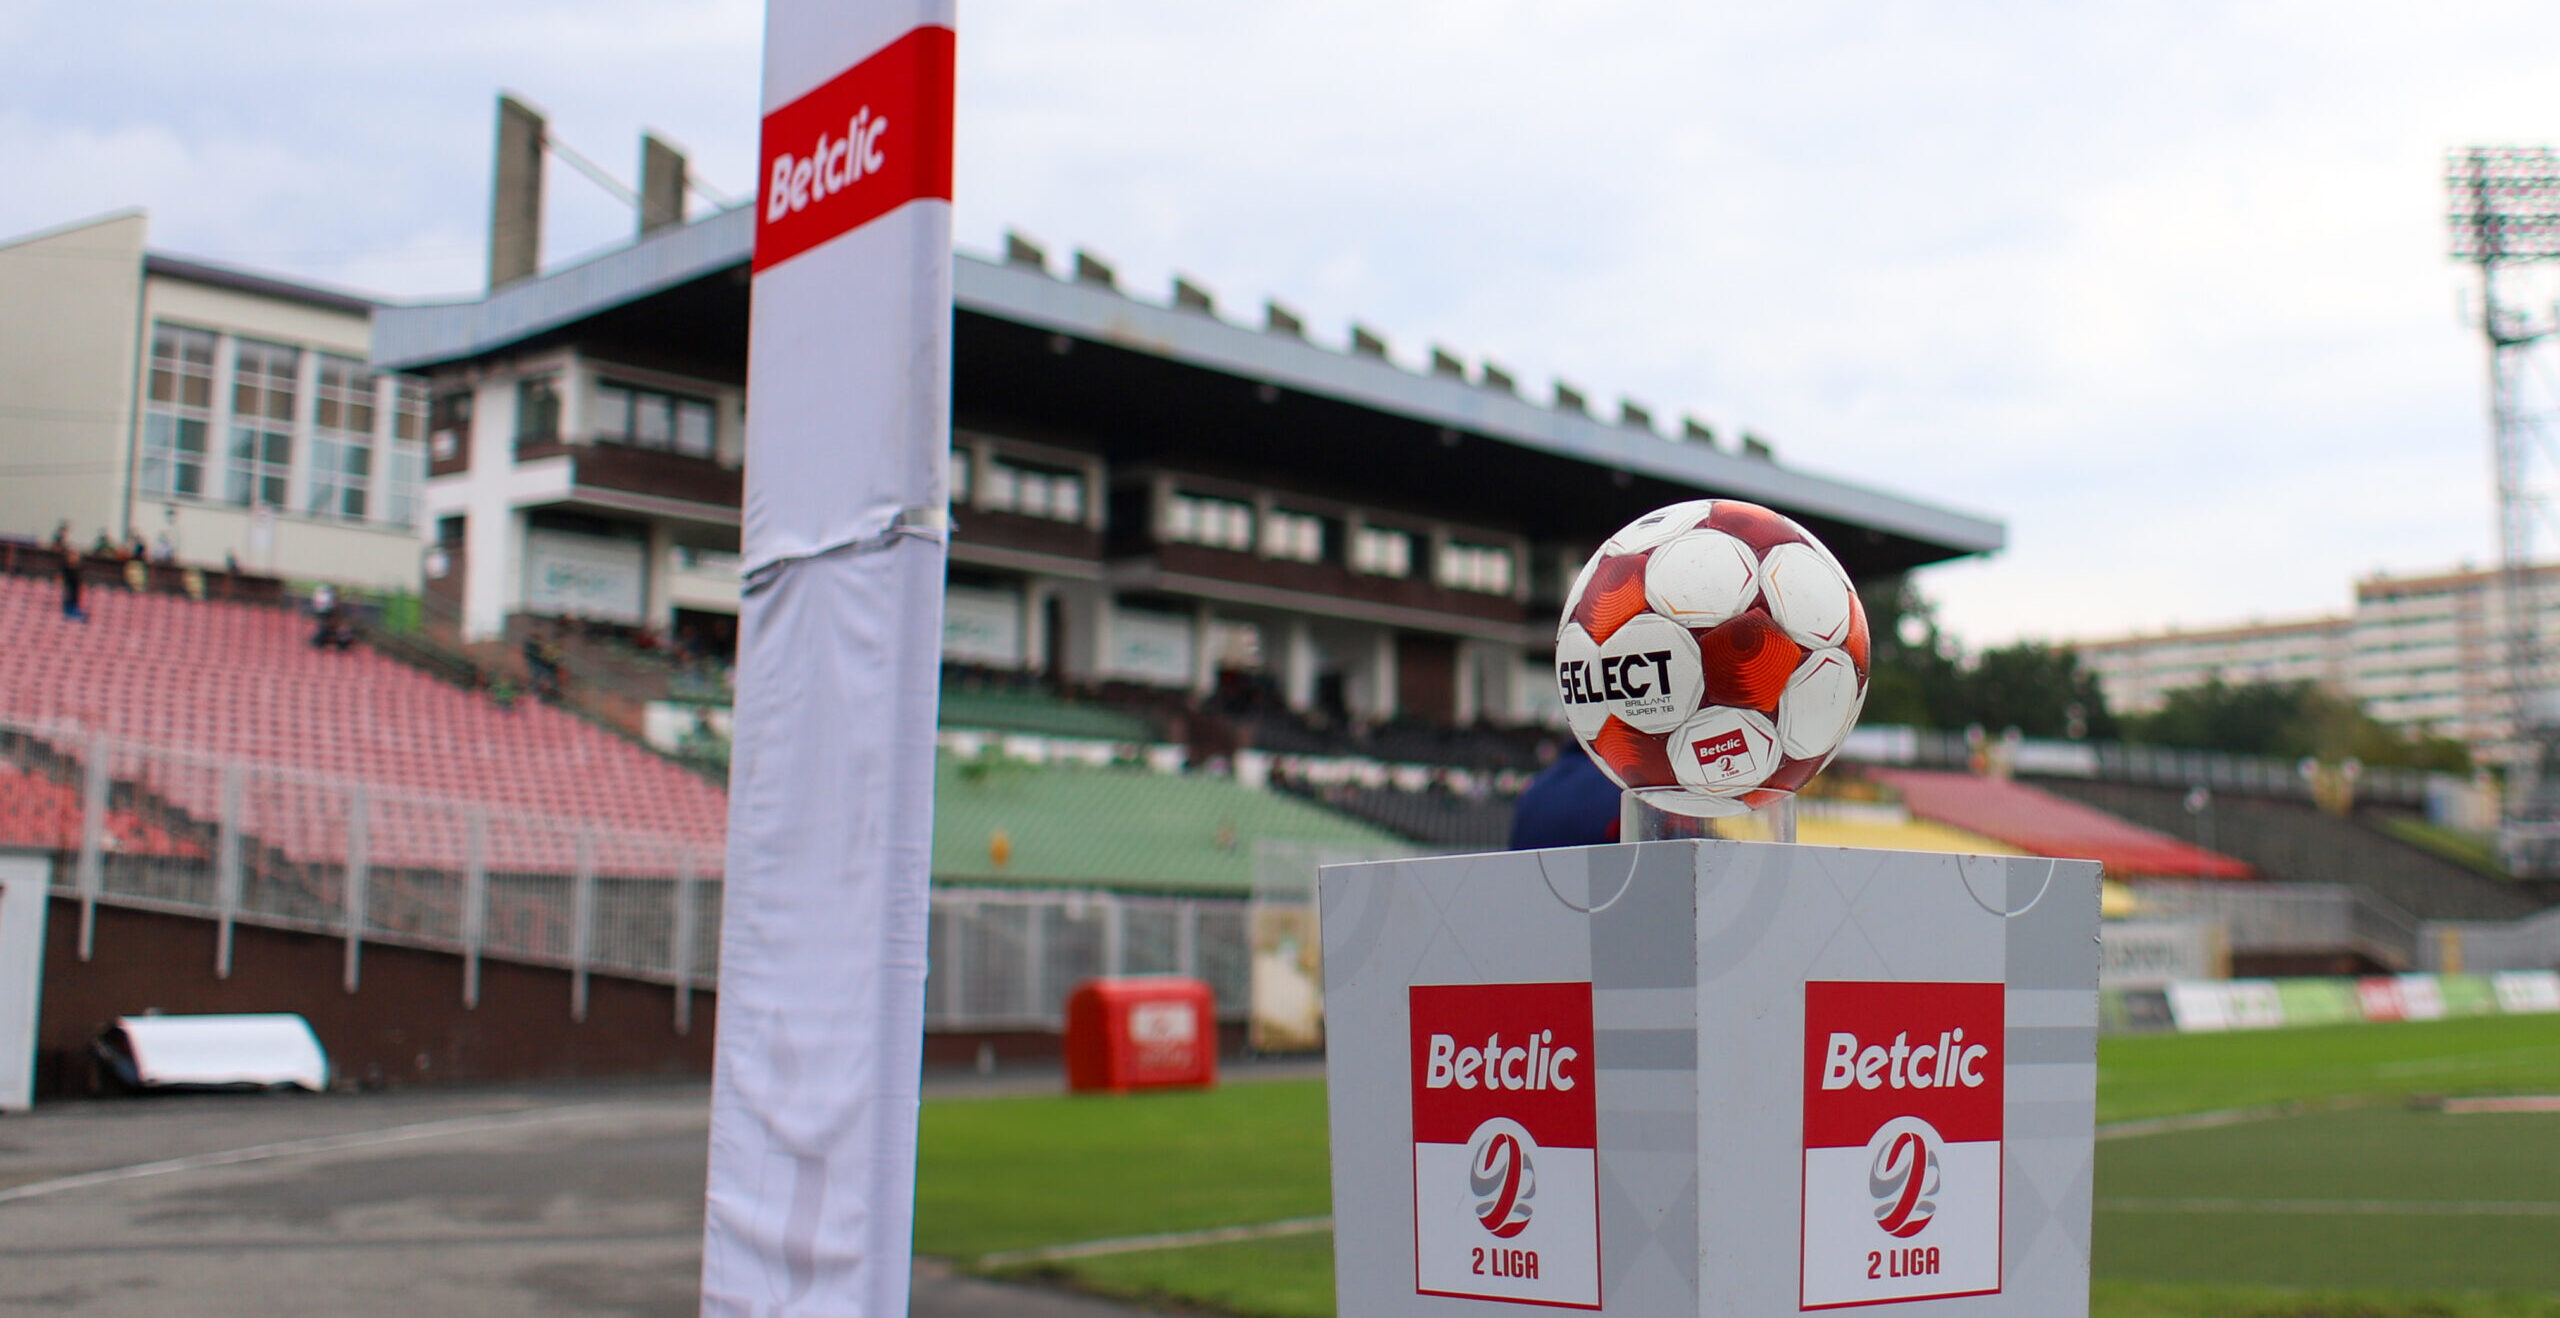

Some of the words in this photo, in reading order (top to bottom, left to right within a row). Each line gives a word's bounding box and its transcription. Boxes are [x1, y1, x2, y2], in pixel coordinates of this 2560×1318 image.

[766, 105, 888, 224] Betclic
[1560, 650, 1672, 704] SELECT
[1625, 696, 1671, 707] BRILLANT
[1625, 707, 1657, 717] SUPER
[1660, 705, 1674, 713] TB
[1700, 739, 1741, 757] Betclic
[1426, 1029, 1578, 1091] Betclic
[1821, 1027, 1988, 1090] Betclic
[1472, 1247, 1485, 1276] 2
[1492, 1248, 1539, 1280] LIGA
[1867, 1250, 1881, 1279] 2
[1890, 1246, 1940, 1278] LIGA
